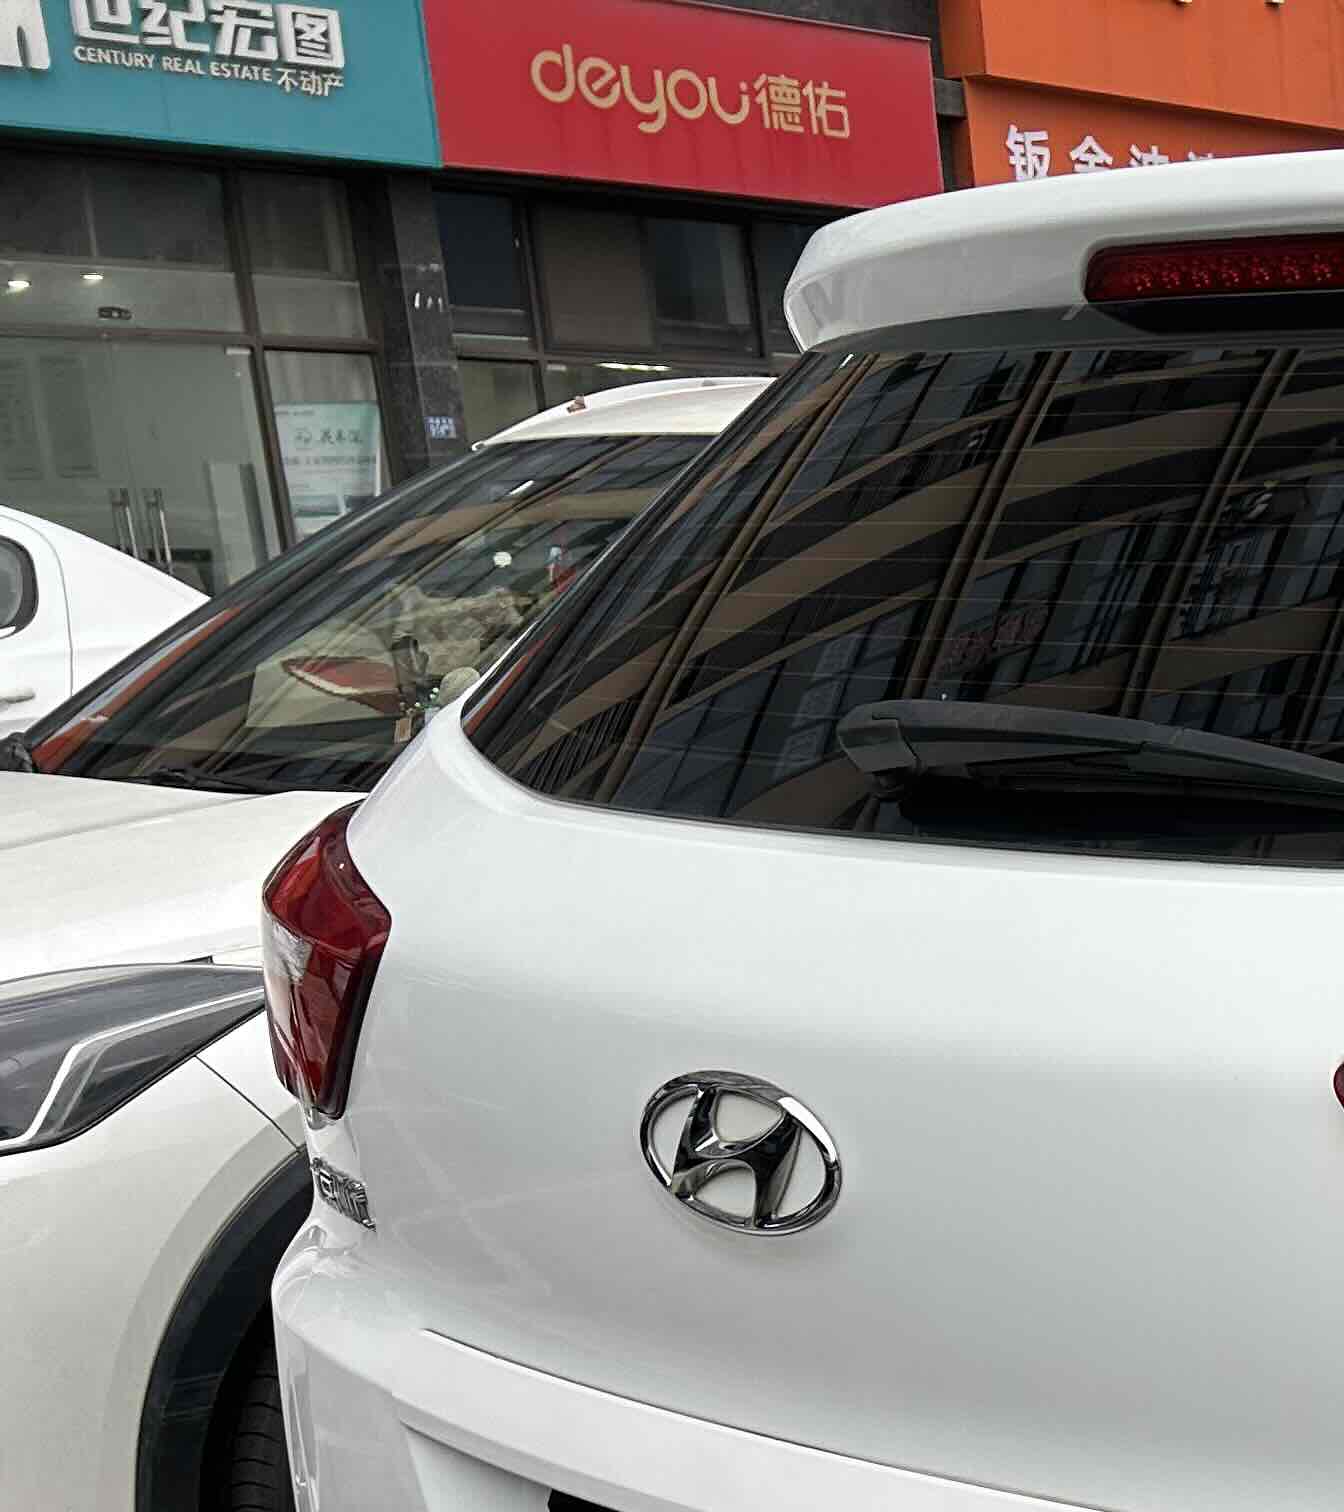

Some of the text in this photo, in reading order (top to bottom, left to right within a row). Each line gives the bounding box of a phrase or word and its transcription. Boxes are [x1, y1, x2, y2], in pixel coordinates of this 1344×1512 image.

[69, 0, 346, 68] 世纪宏图
[73, 46, 272, 82] CENTURY REAL ESTATE
[276, 68, 344, 97] 不动产
[530, 43, 850, 139] deyou 德佑
